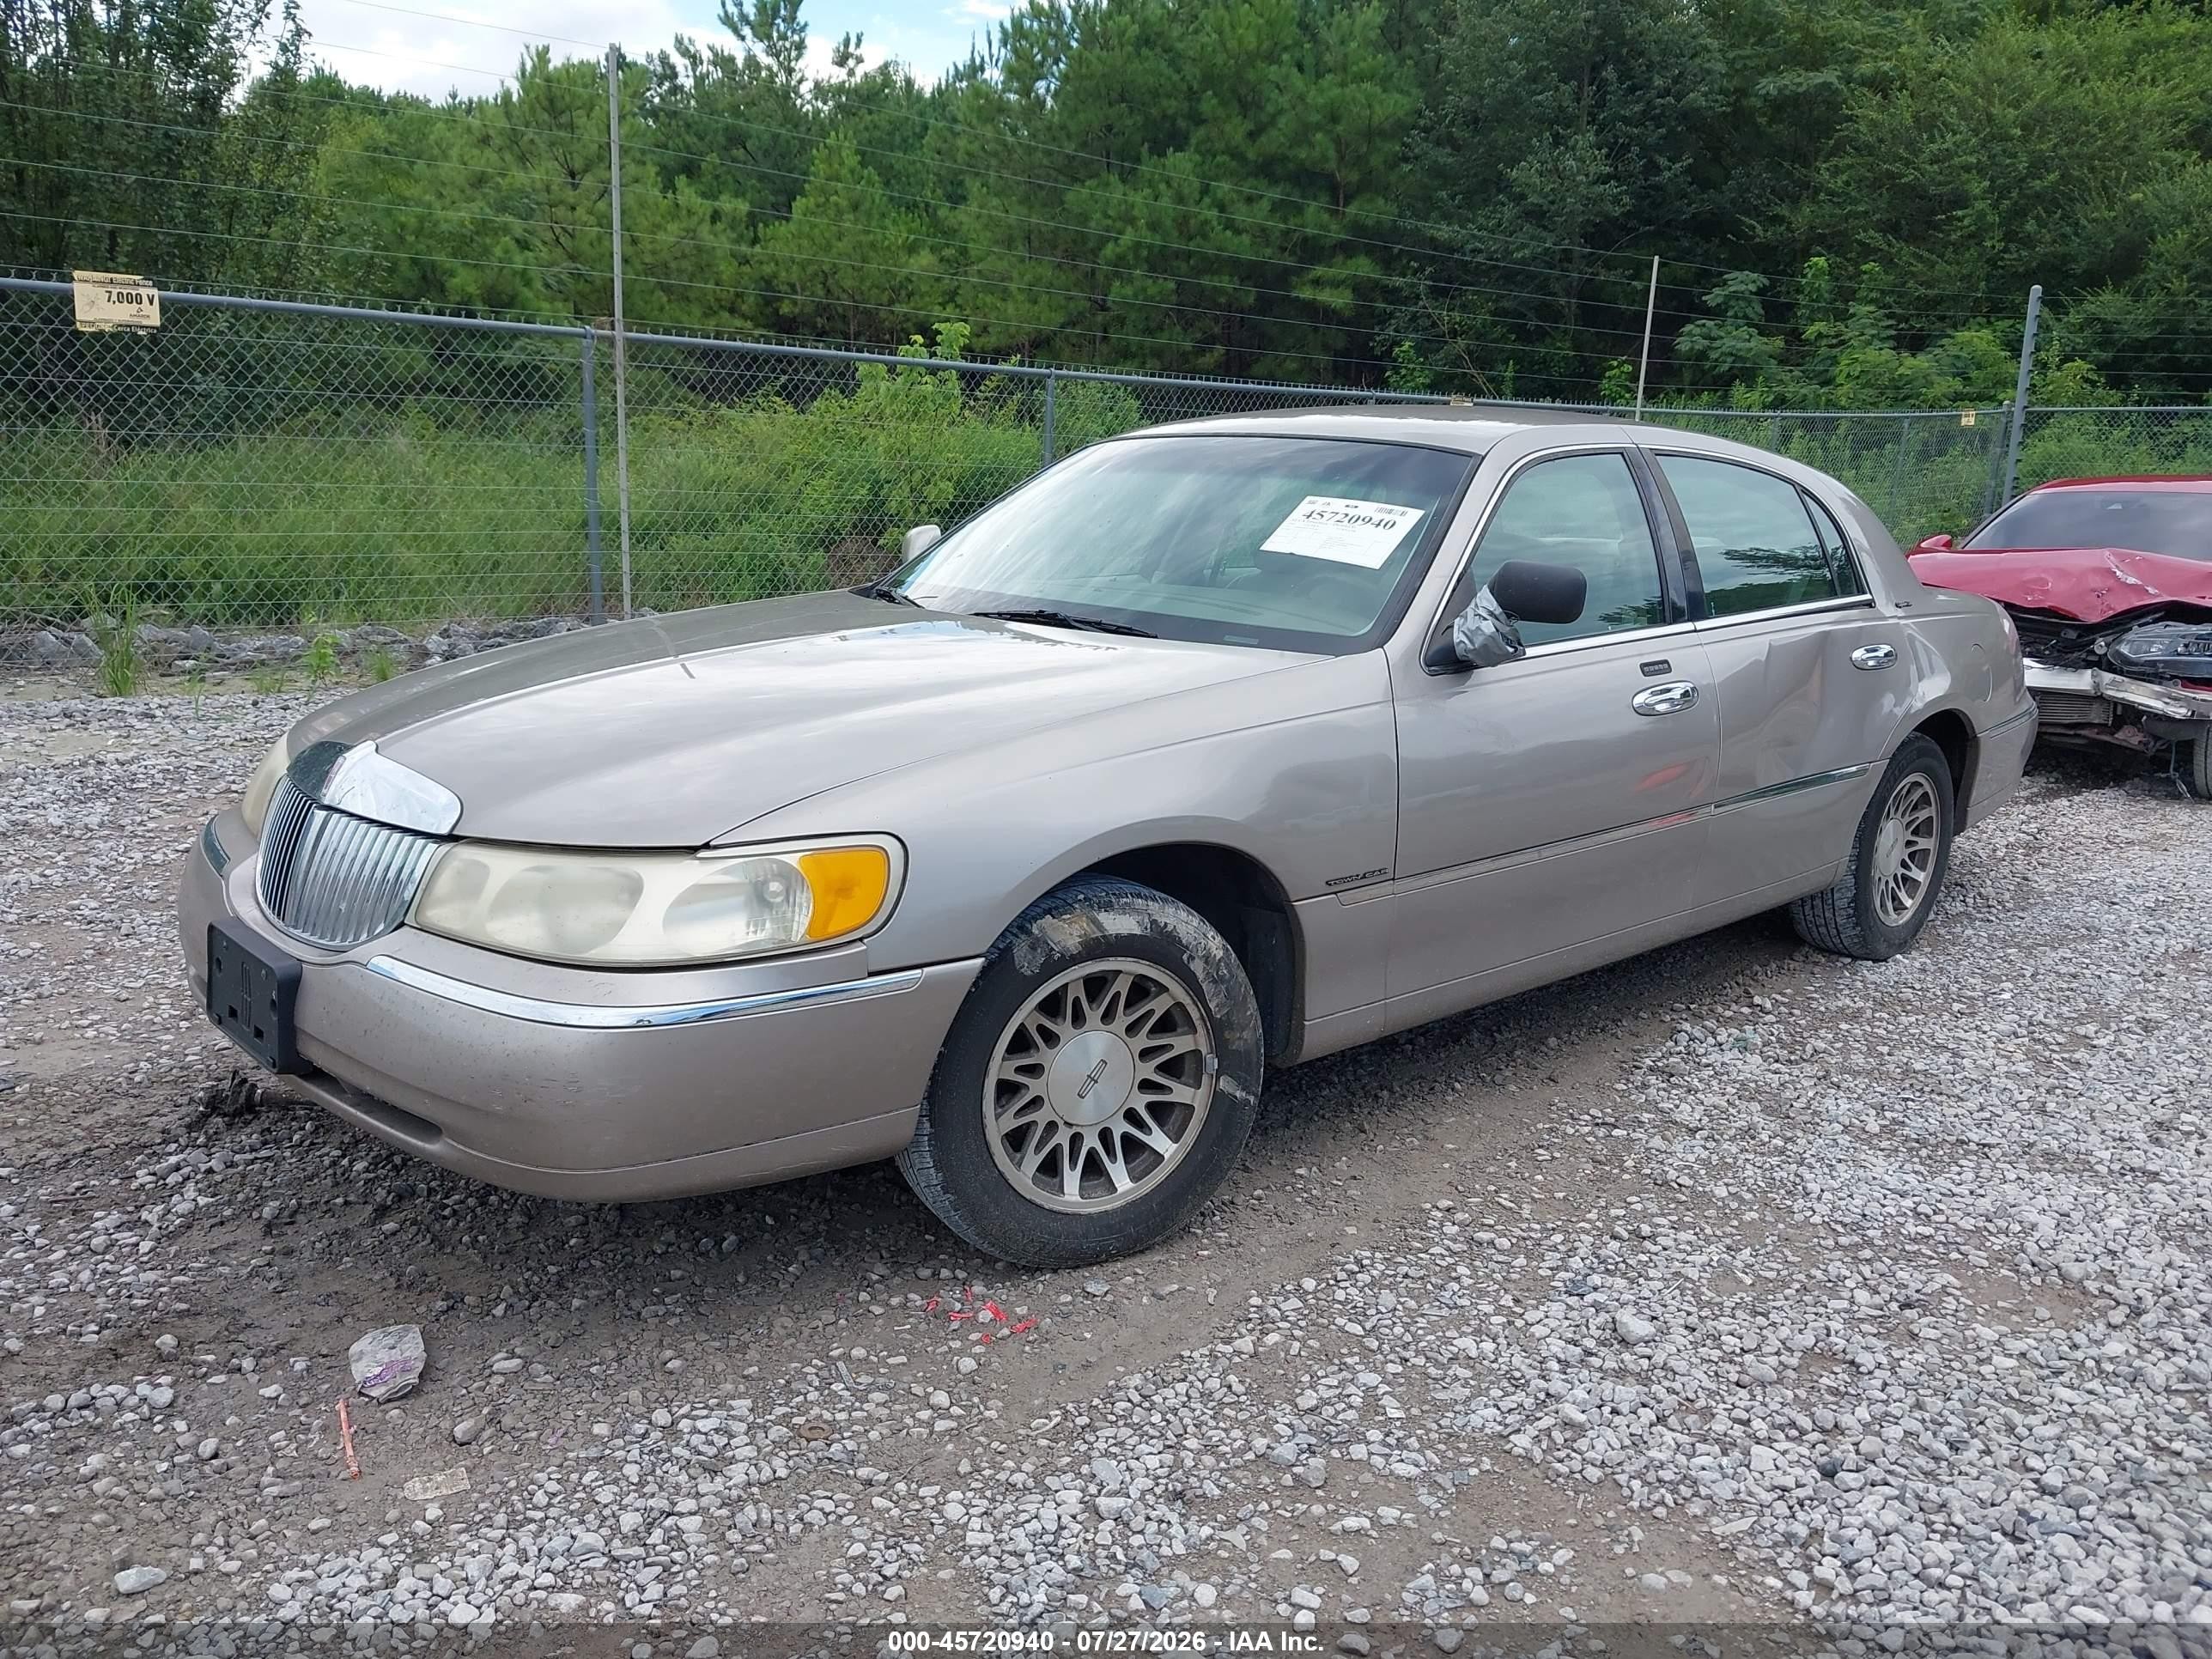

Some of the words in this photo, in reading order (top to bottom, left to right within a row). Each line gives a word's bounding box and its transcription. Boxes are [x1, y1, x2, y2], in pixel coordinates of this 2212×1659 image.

[105, 290, 143, 305] 7,000
[146, 294, 155, 307] V
[1302, 509, 1396, 531] 45720940
[1327, 874, 1362, 886] TOWN
[1364, 867, 1389, 878] CAR
